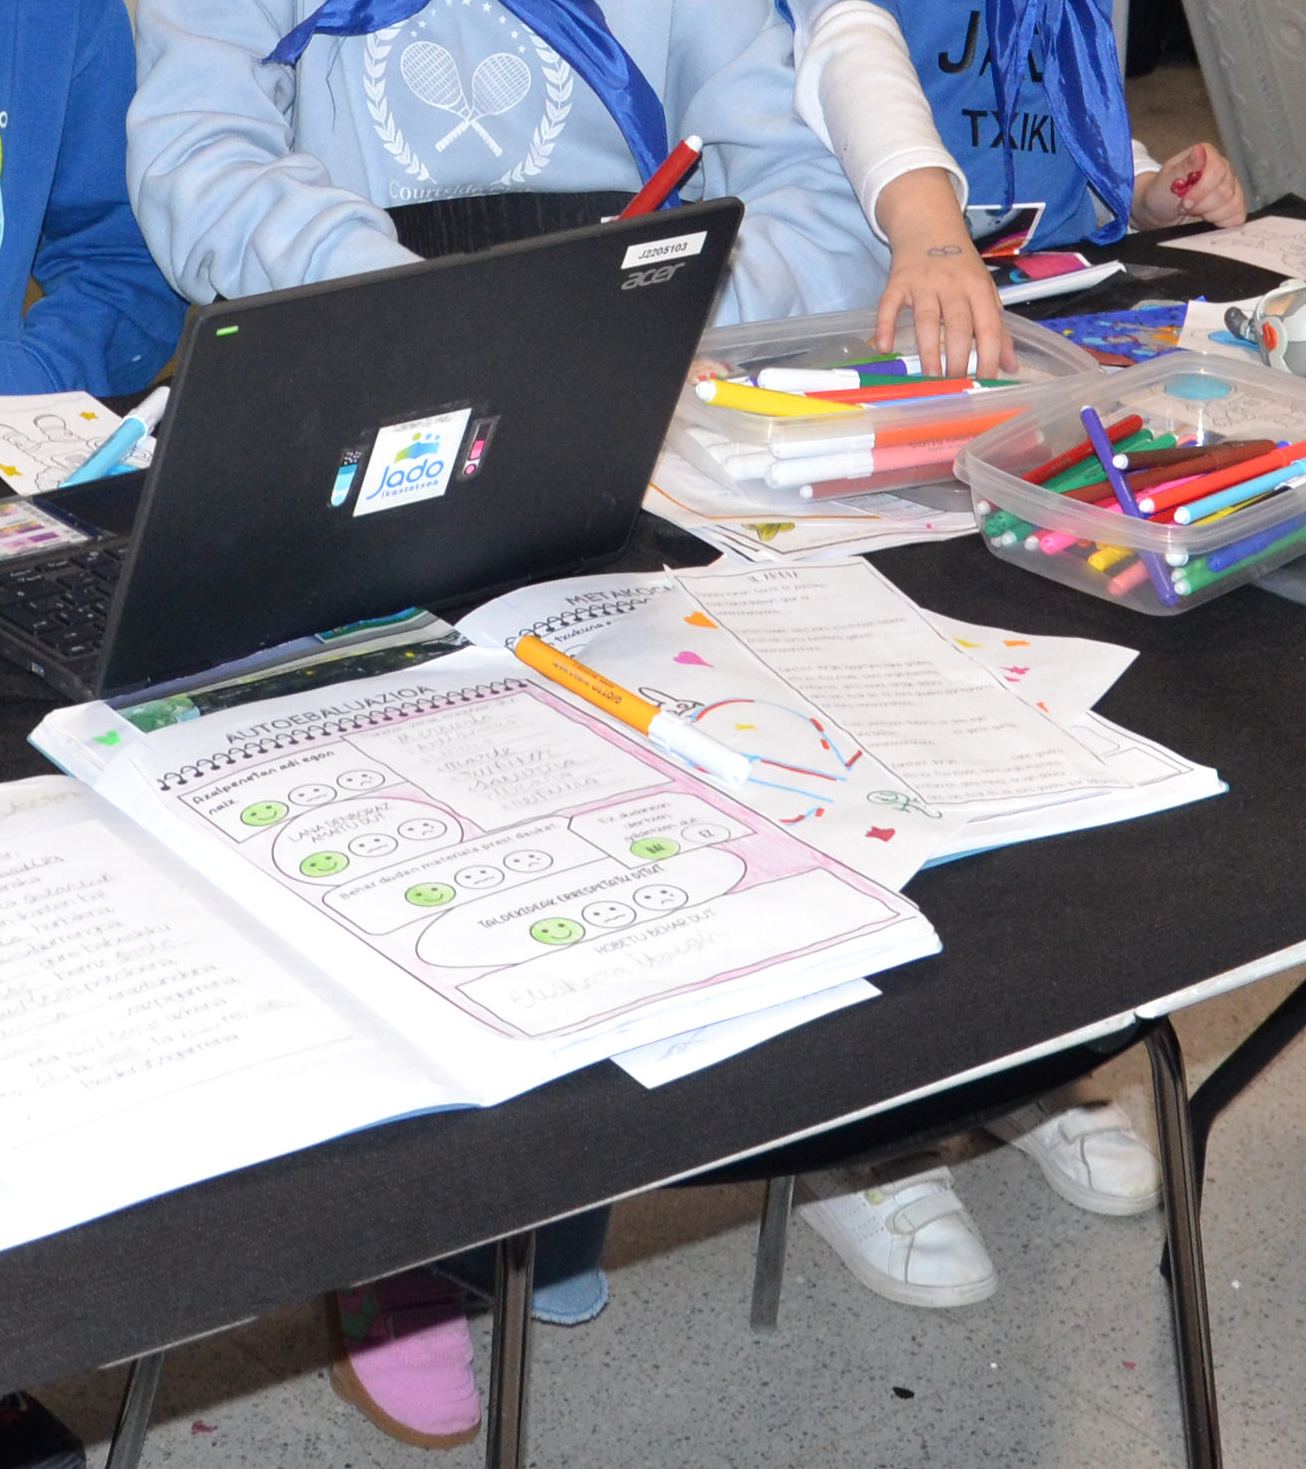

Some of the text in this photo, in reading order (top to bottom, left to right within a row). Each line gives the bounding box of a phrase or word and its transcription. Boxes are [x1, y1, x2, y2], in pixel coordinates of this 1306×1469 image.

[961, 108, 1058, 155] TXIKI
[620, 261, 686, 292] acer
[366, 459, 445, 501] Jado
[224, 685, 437, 745] AUTOEBALUAZIOA
[192, 750, 335, 806] Azalpenetan adi egon
[644, 842, 665, 855] BAI
[339, 879, 378, 902] Behar
